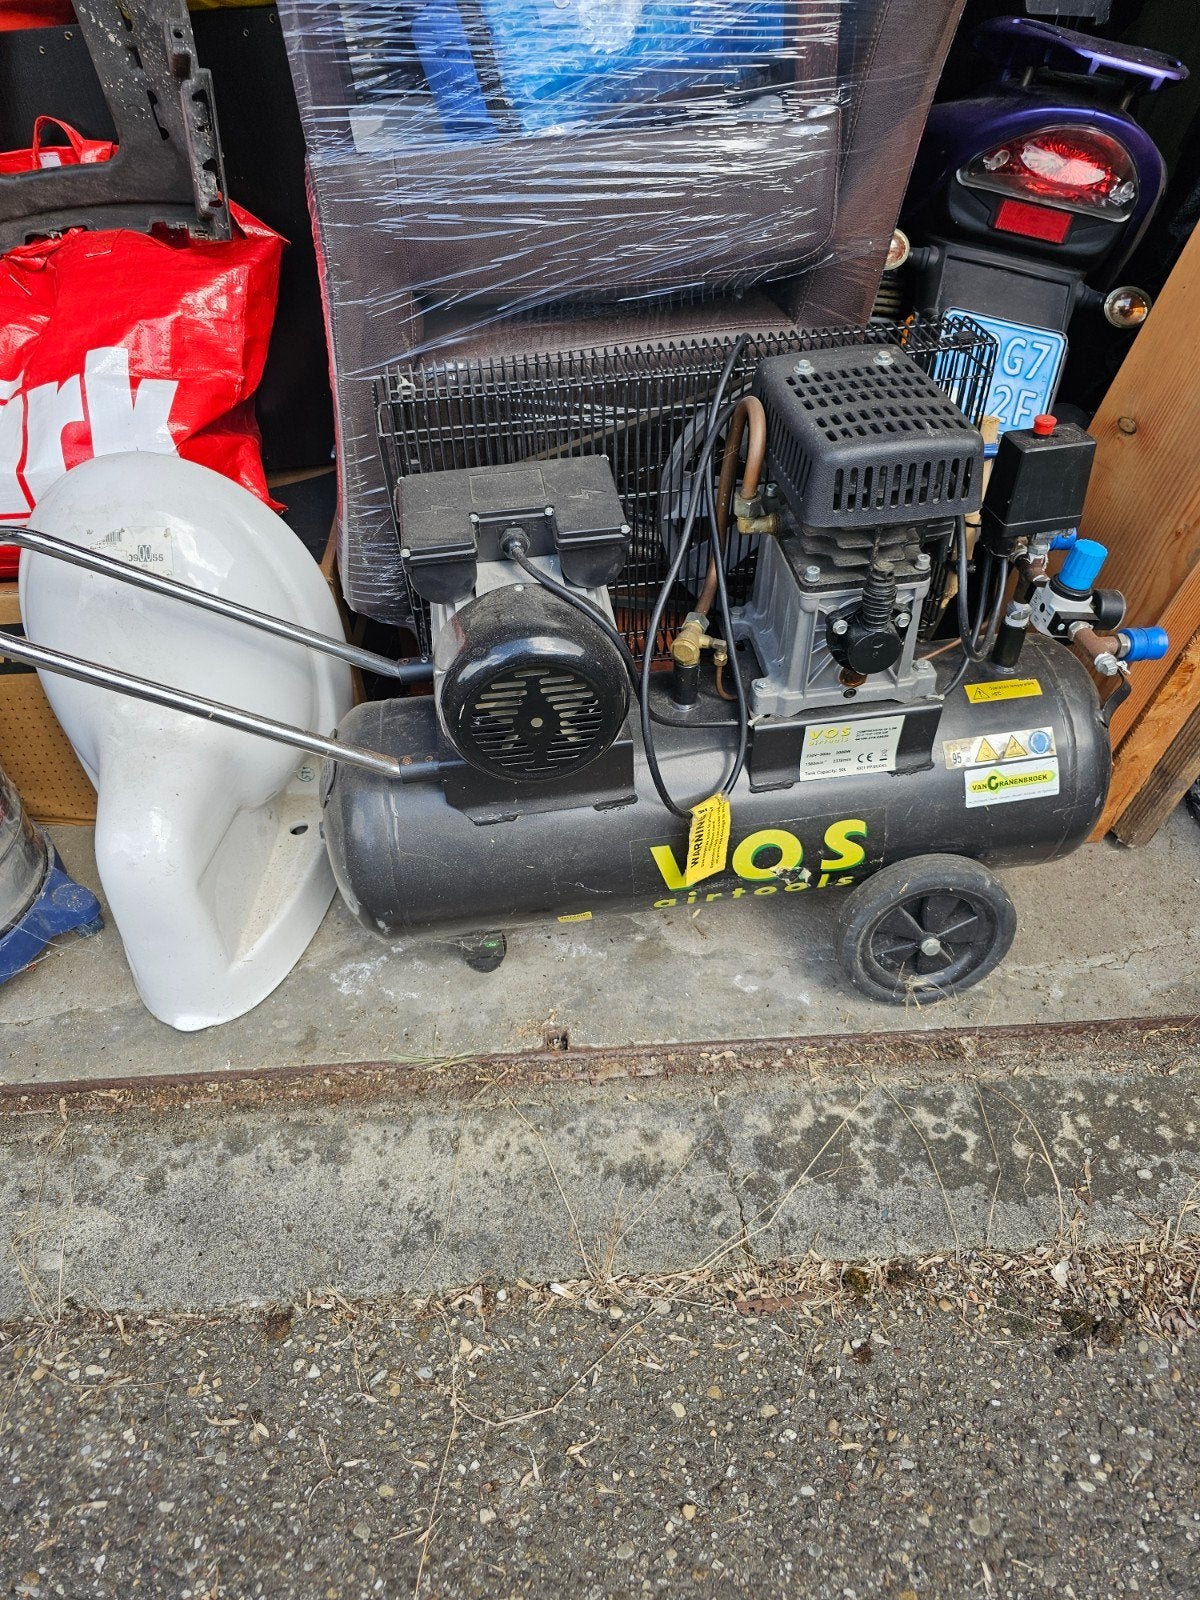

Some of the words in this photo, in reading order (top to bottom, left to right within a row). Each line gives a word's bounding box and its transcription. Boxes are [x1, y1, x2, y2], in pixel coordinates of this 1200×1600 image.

[808, 726, 852, 740] VOS
[857, 752, 874, 764] CE
[952, 752, 962, 765] 95
[650, 819, 868, 892] VOS
[653, 873, 855, 908] airtools
